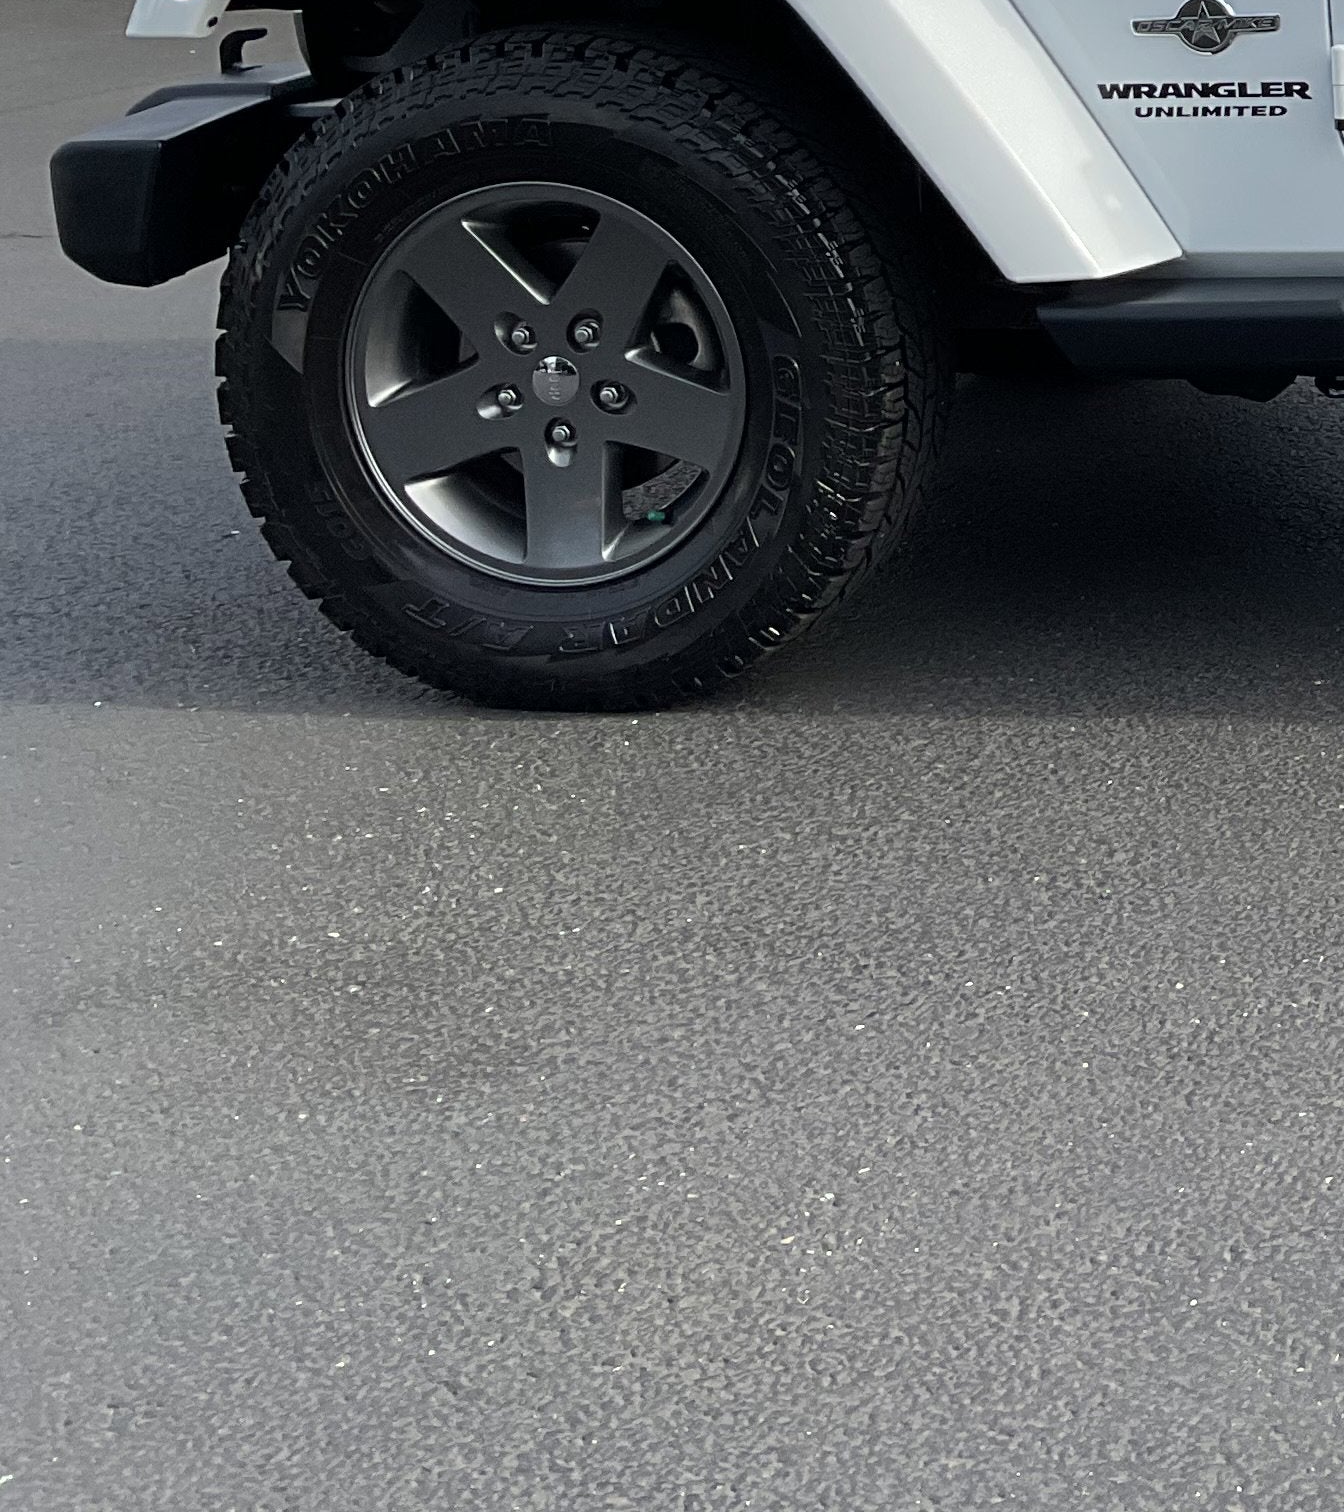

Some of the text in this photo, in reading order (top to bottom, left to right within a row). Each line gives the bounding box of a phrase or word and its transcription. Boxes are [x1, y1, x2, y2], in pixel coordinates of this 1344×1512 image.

[1097, 81, 1313, 99] WRANGLER
[1135, 105, 1288, 117] UNLIMITED
[277, 117, 554, 314] YOKOHAMA
[558, 354, 807, 653] GEOLANDAR
